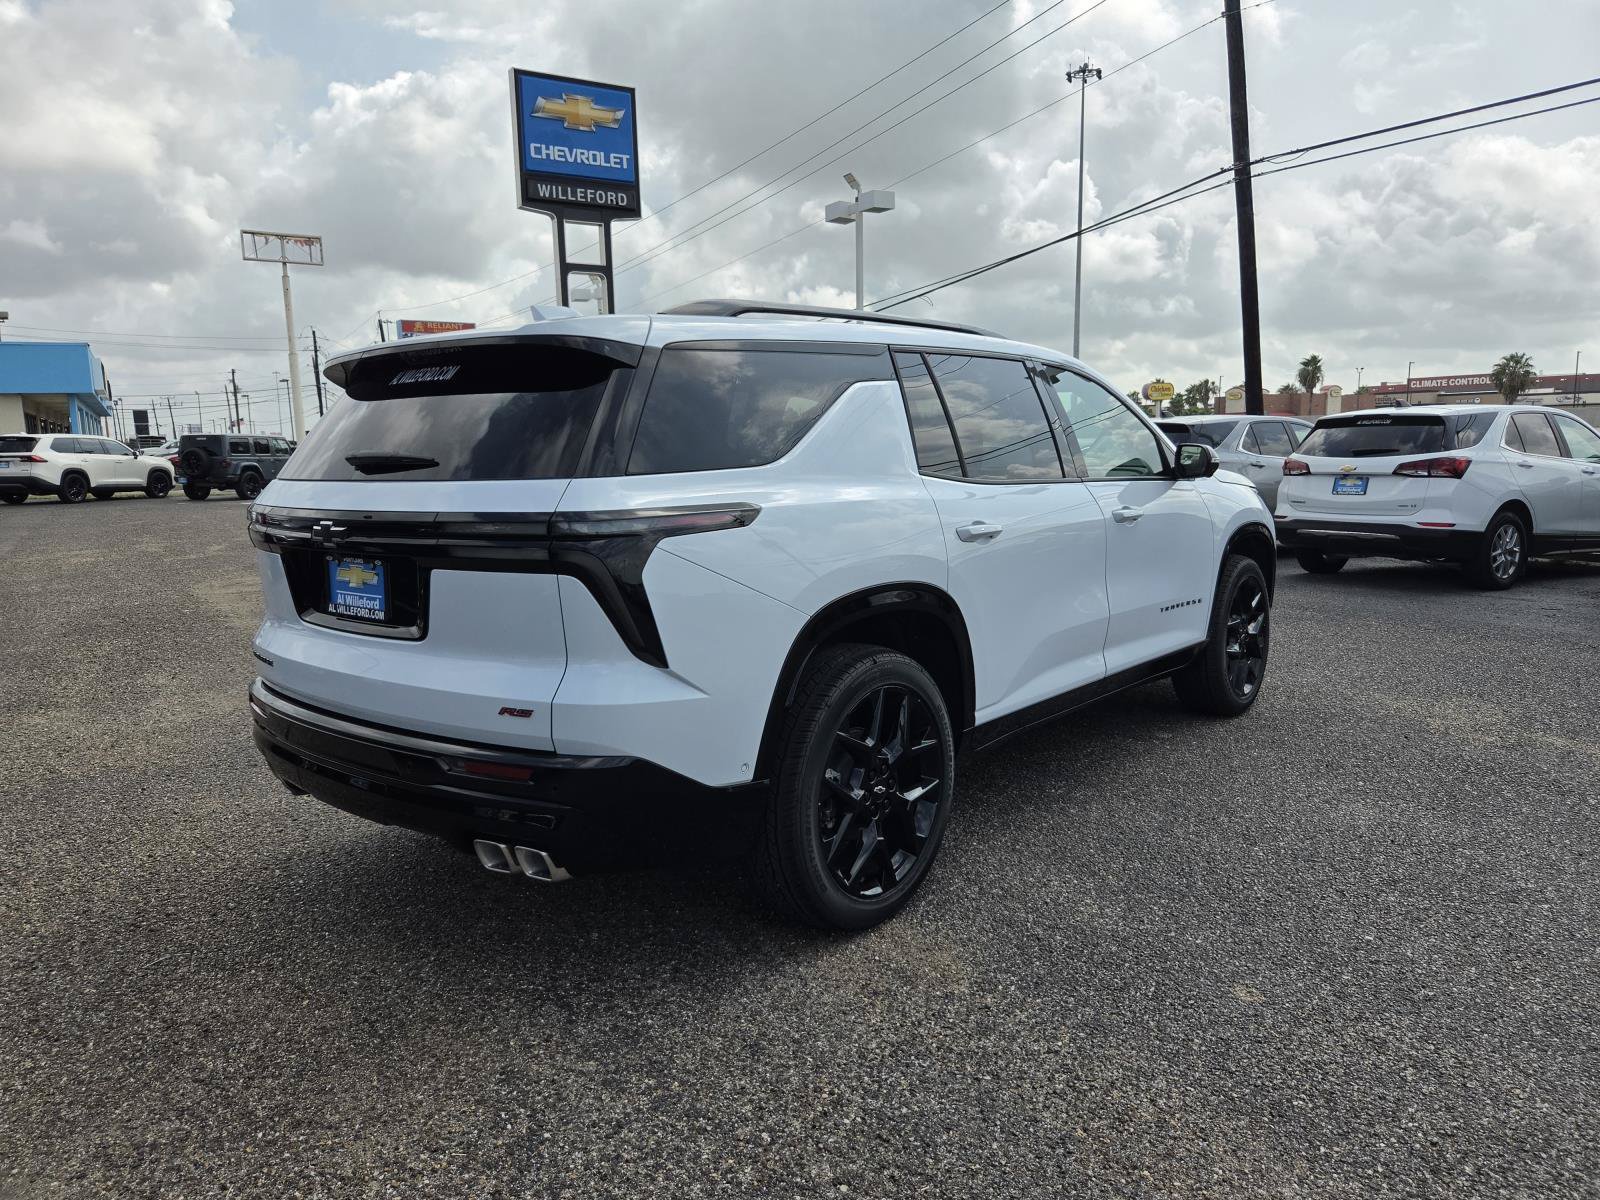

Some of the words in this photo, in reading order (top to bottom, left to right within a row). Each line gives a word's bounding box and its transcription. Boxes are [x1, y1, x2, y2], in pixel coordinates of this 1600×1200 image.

[530, 142, 630, 169] CHEVROLET
[538, 183, 627, 206] WILLEFORD
[427, 321, 464, 330] RELIANT
[1410, 379, 1448, 388] CLIMATE
[1449, 376, 1491, 386] CONTROL
[345, 594, 380, 609] Willeford
[1159, 598, 1203, 613] TRAVERSE
[328, 603, 336, 613] AL
[336, 604, 385, 620] WILLEFORD.COM
[497, 706, 534, 718] RS
